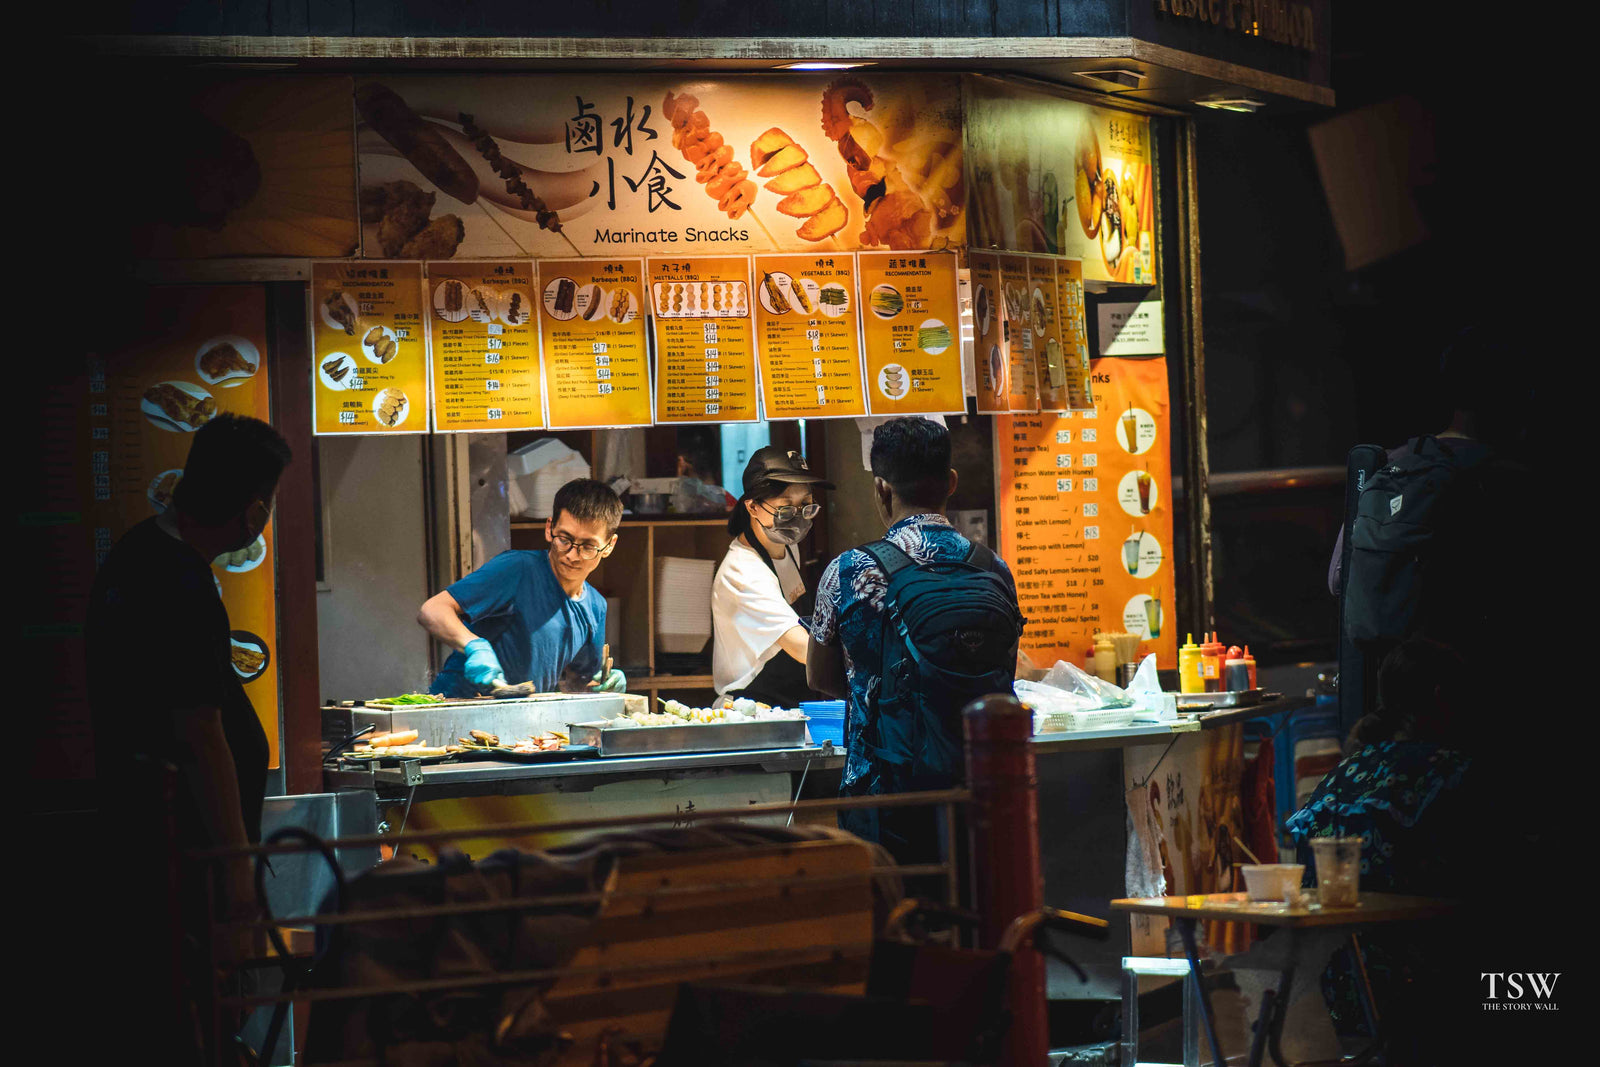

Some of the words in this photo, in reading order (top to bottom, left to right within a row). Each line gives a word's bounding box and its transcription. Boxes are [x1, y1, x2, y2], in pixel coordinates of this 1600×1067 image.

[565, 95, 658, 156] 鹵水
[589, 150, 686, 213] 小食
[593, 228, 678, 244] Marinate
[685, 227, 749, 242] Snacks
[592, 276, 618, 284] Barbeque
[705, 323, 717, 333] $14
[705, 334, 717, 343] $14
[489, 339, 502, 349] $17
[593, 343, 606, 352] $17
[486, 353, 500, 363] $16
[706, 349, 717, 358] $14
[596, 357, 609, 366] $14
[706, 362, 718, 372] $14
[598, 369, 610, 378] $14
[487, 381, 499, 390] $14
[706, 376, 718, 386] $14
[599, 384, 611, 394] $16
[706, 389, 718, 399] $14
[488, 409, 501, 419] $14
[706, 404, 718, 414] $14
[1029, 420, 1042, 428] Tea)
[1013, 445, 1036, 453] (Lemon
[1014, 470, 1037, 478] (Lemon
[1072, 467, 1094, 476] Honey)
[1014, 495, 1037, 503] (Lemon
[1039, 493, 1060, 501] Water)
[1088, 554, 1099, 562] $20
[1018, 593, 1039, 601] (Citron
[1066, 591, 1088, 599] Honey)
[1080, 615, 1100, 623] Sprite)
[1057, 640, 1070, 648] Tea)
